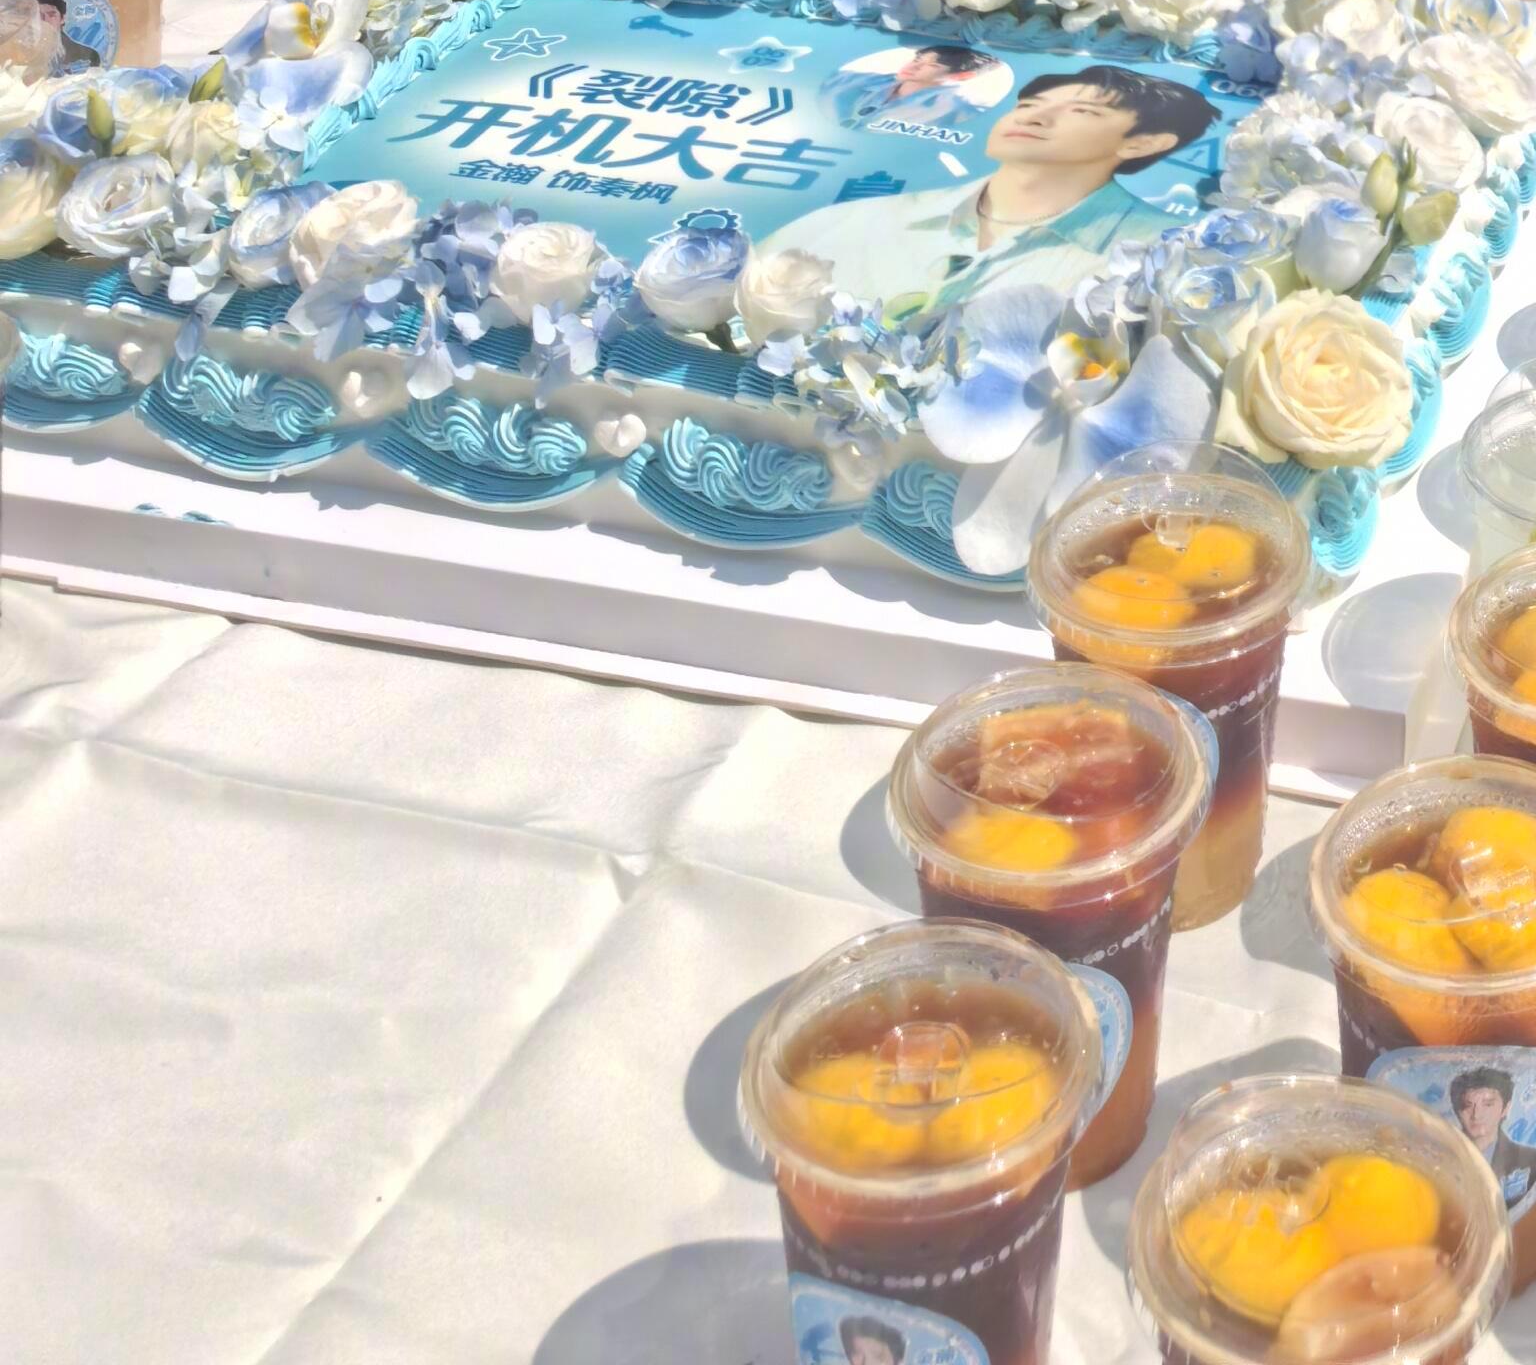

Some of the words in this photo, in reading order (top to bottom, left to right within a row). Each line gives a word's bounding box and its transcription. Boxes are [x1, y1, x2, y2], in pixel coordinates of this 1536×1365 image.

[528, 63, 793, 126] 《裂隙》
[386, 99, 853, 191] 开机大吉
[869, 119, 972, 144] JINHAN
